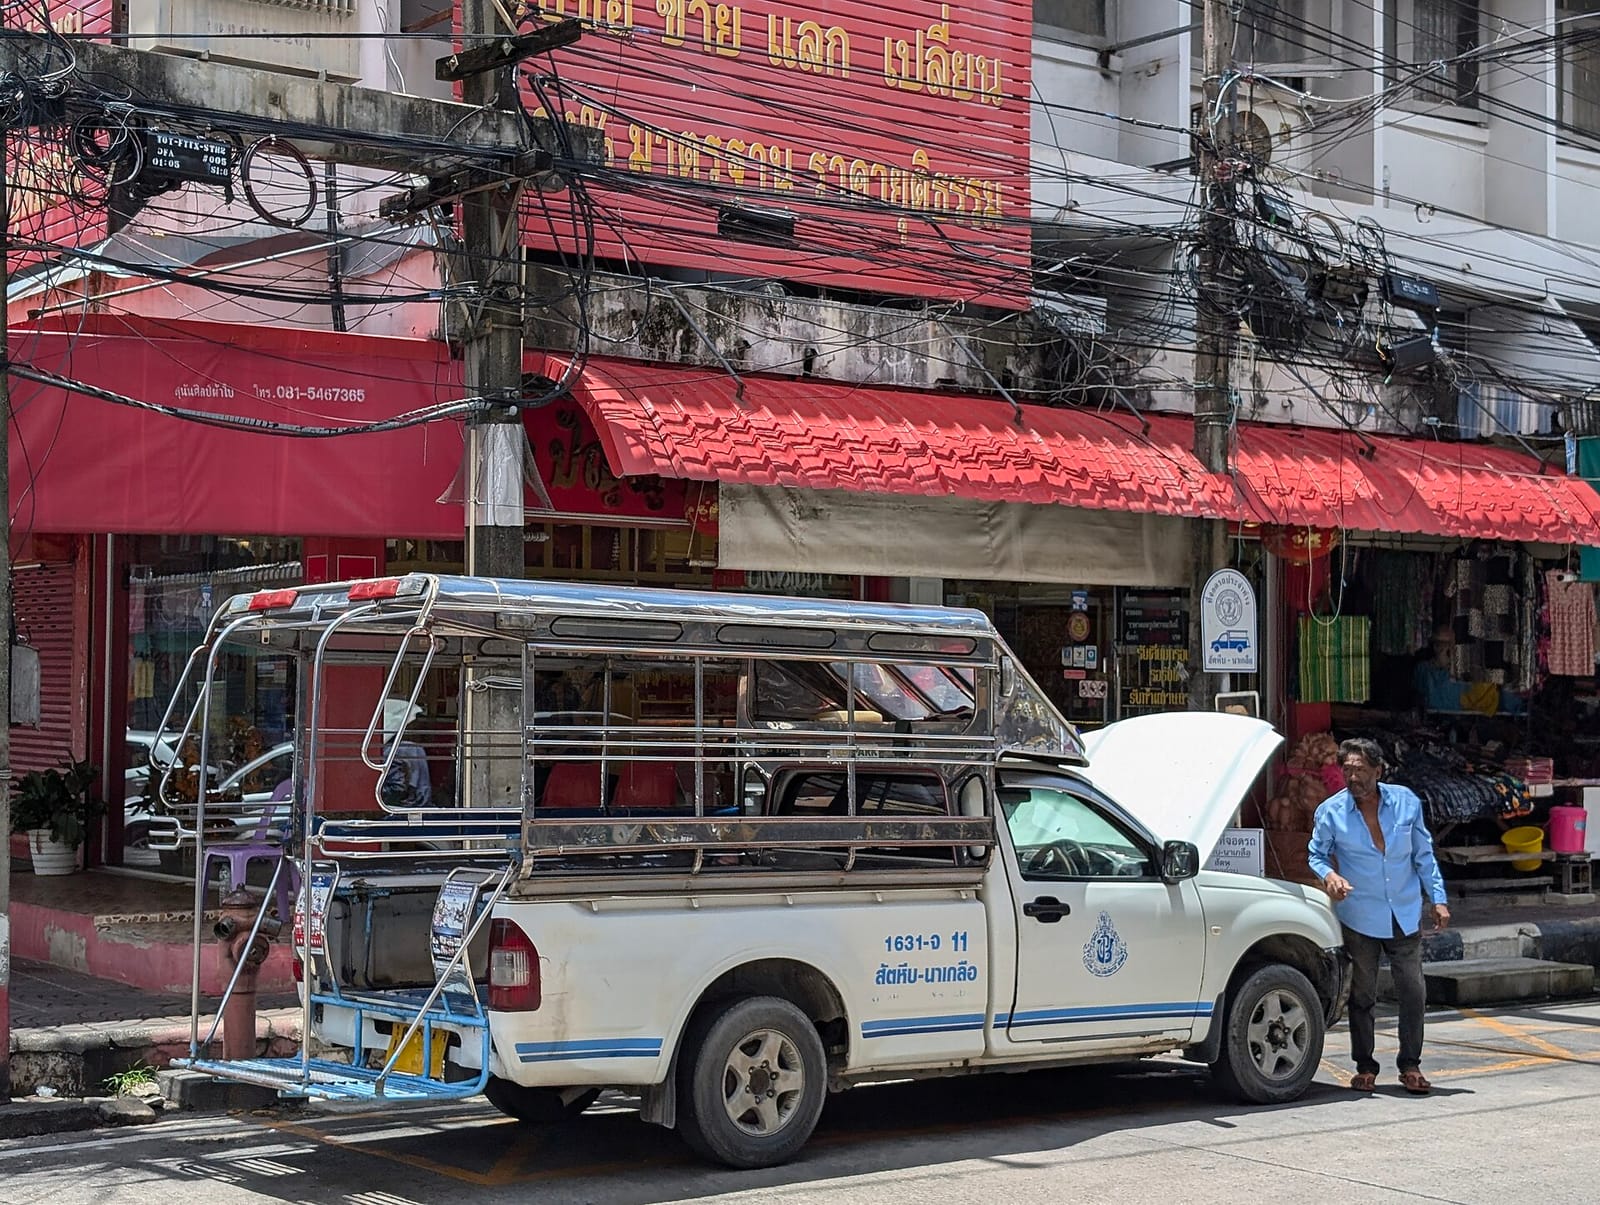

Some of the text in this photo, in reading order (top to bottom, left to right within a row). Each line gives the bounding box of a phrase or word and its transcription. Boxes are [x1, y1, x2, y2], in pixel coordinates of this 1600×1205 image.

[768, 13, 850, 79] แลก
[884, 3, 1004, 107] เปลี่ยน
[629, 123, 794, 194] มาตรฐาน
[885, 931, 968, 952] 1631-จ 11
[875, 960, 978, 985] สัตหีบ-นาเกลือ
